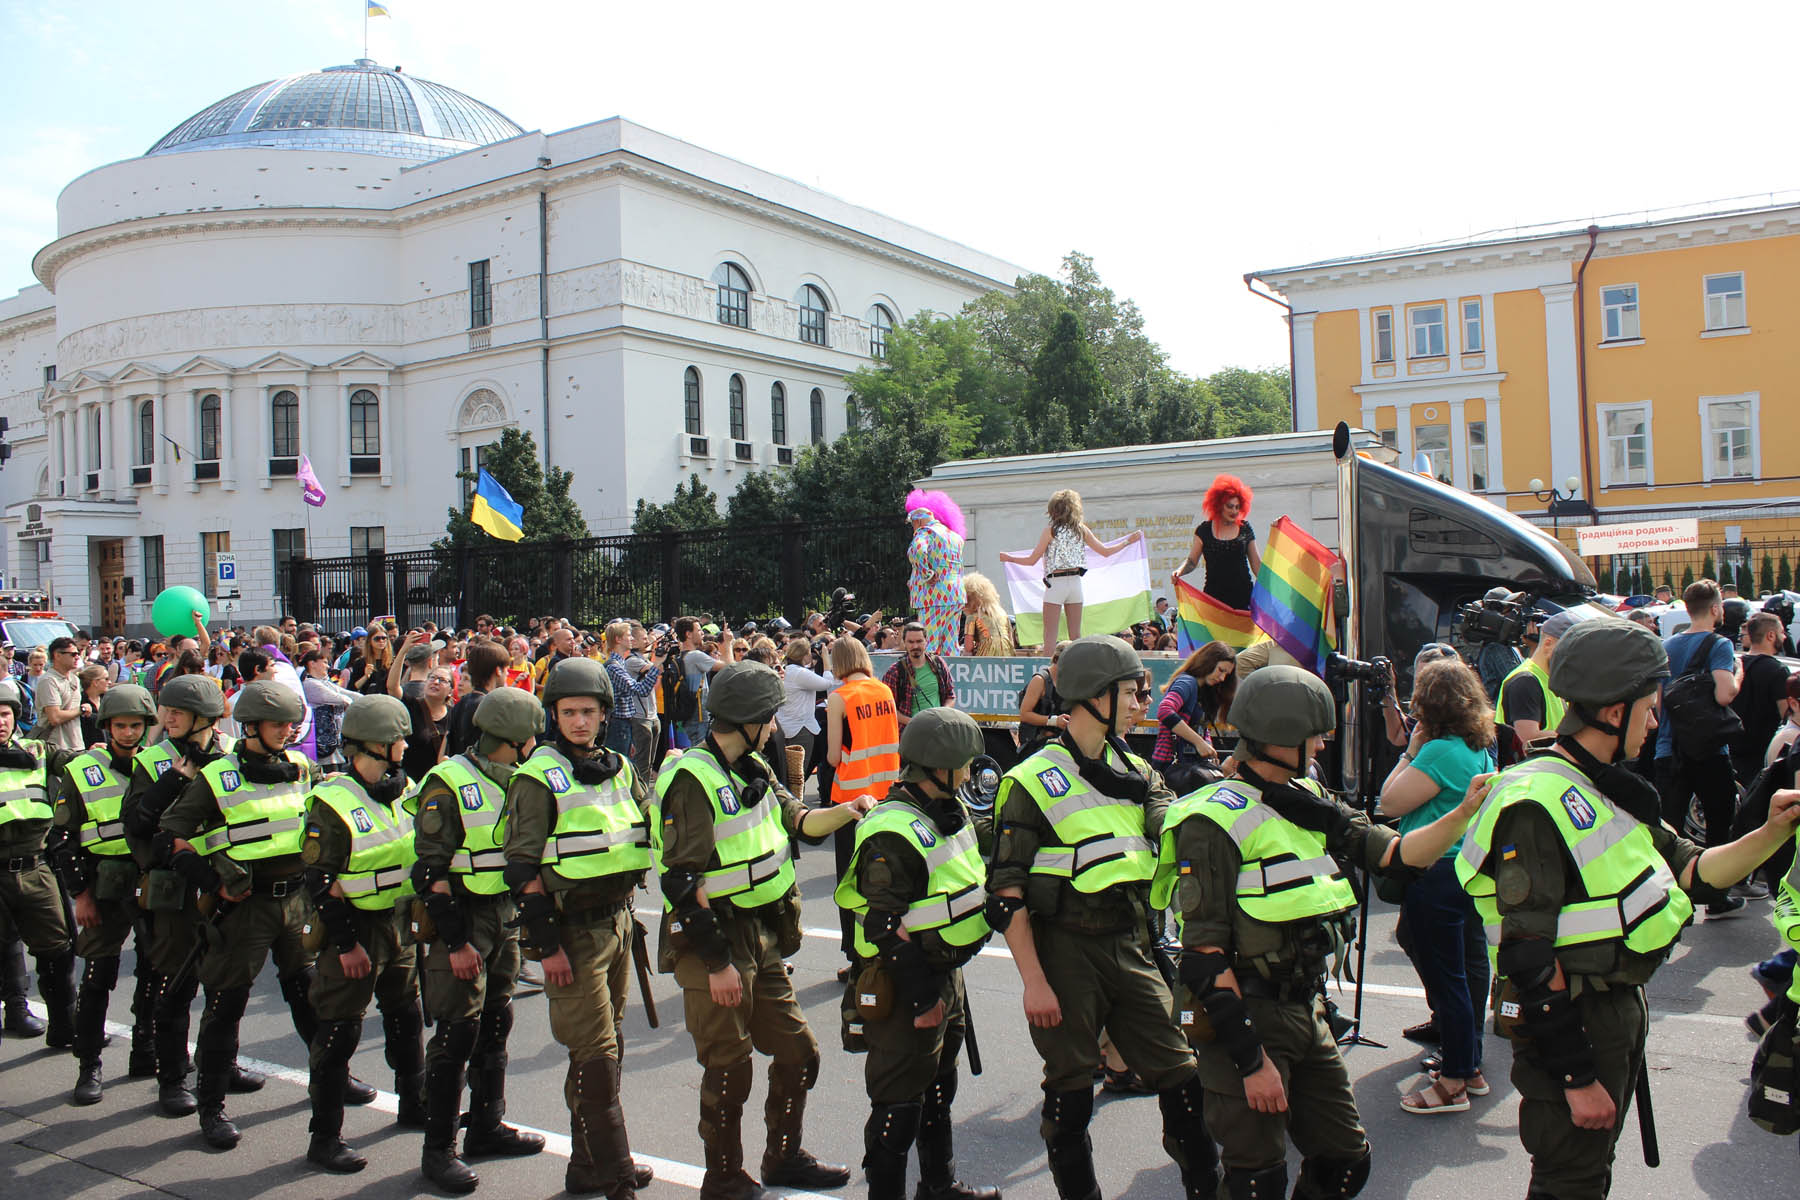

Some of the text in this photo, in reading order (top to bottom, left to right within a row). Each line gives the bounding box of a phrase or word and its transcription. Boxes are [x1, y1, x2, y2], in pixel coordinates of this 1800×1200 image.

[1577, 526, 1634, 541] Традиційна
[1635, 525, 1674, 537] родина
[1617, 538, 1660, 549] здорова
[217, 554, 235, 562] ЗОНА
[222, 564, 233, 579] P
[949, 663, 1025, 684] KRAINE
[957, 688, 1019, 710] UNTR
[855, 700, 895, 721] NO HAT
